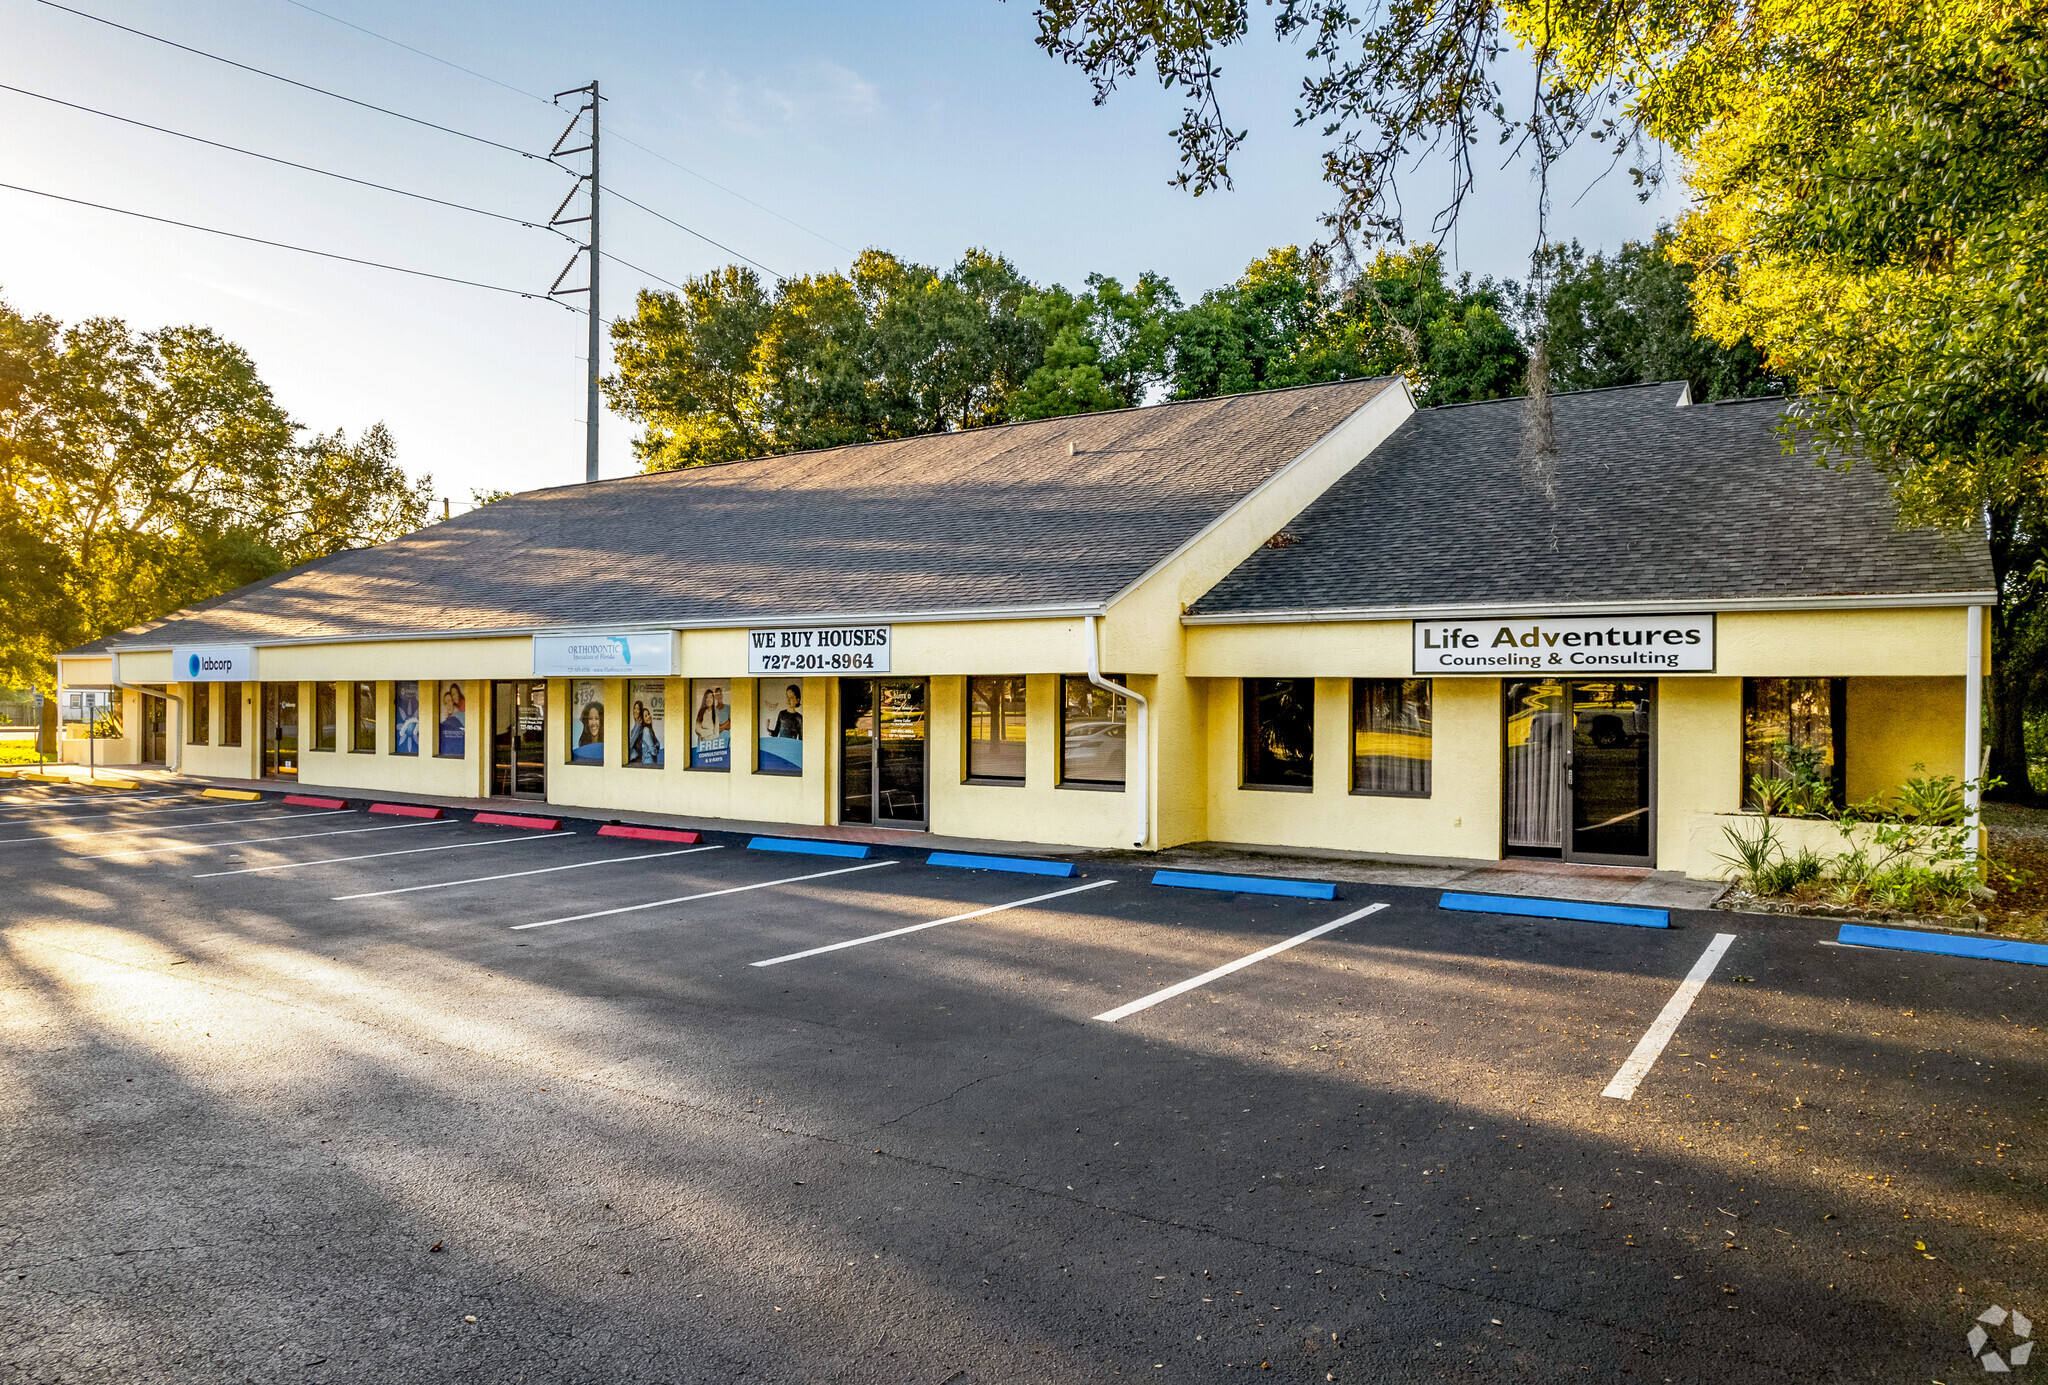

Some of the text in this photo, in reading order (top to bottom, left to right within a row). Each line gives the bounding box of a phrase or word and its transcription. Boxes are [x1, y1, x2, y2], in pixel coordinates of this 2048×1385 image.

[752, 628, 887, 648] WE BUY HOUSES
[1424, 626, 1701, 649] Life Adventures
[568, 644, 621, 654] ORTHODONTIC
[202, 656, 232, 673] labcorp
[762, 653, 874, 669] 727-201-8964
[1439, 651, 1680, 669] Counseling & Consulting
[700, 738, 725, 752] FREE
